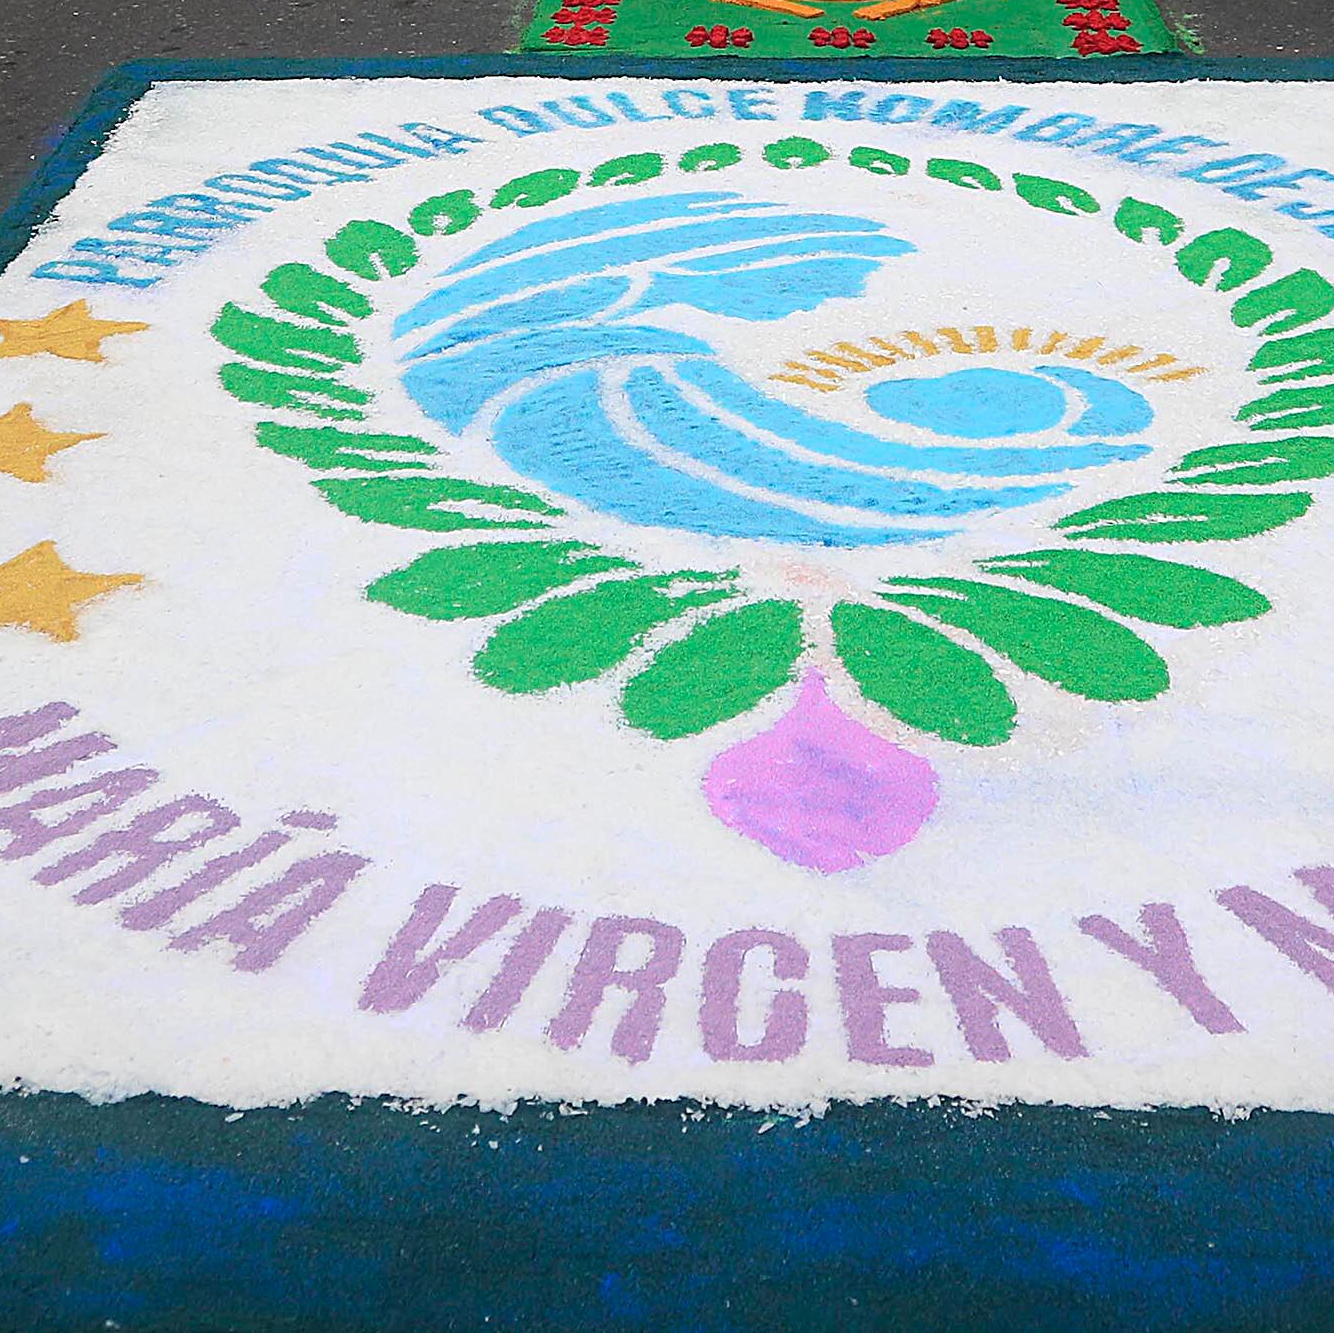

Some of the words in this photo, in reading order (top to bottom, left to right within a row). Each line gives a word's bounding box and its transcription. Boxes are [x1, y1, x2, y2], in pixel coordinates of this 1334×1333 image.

[29, 121, 485, 288] PARROQUIA
[478, 89, 778, 138] DULCE
[800, 90, 1228, 165] NOMBRE
[356, 884, 1090, 1068] VIRGEN
[1077, 902, 1247, 1034] Y
